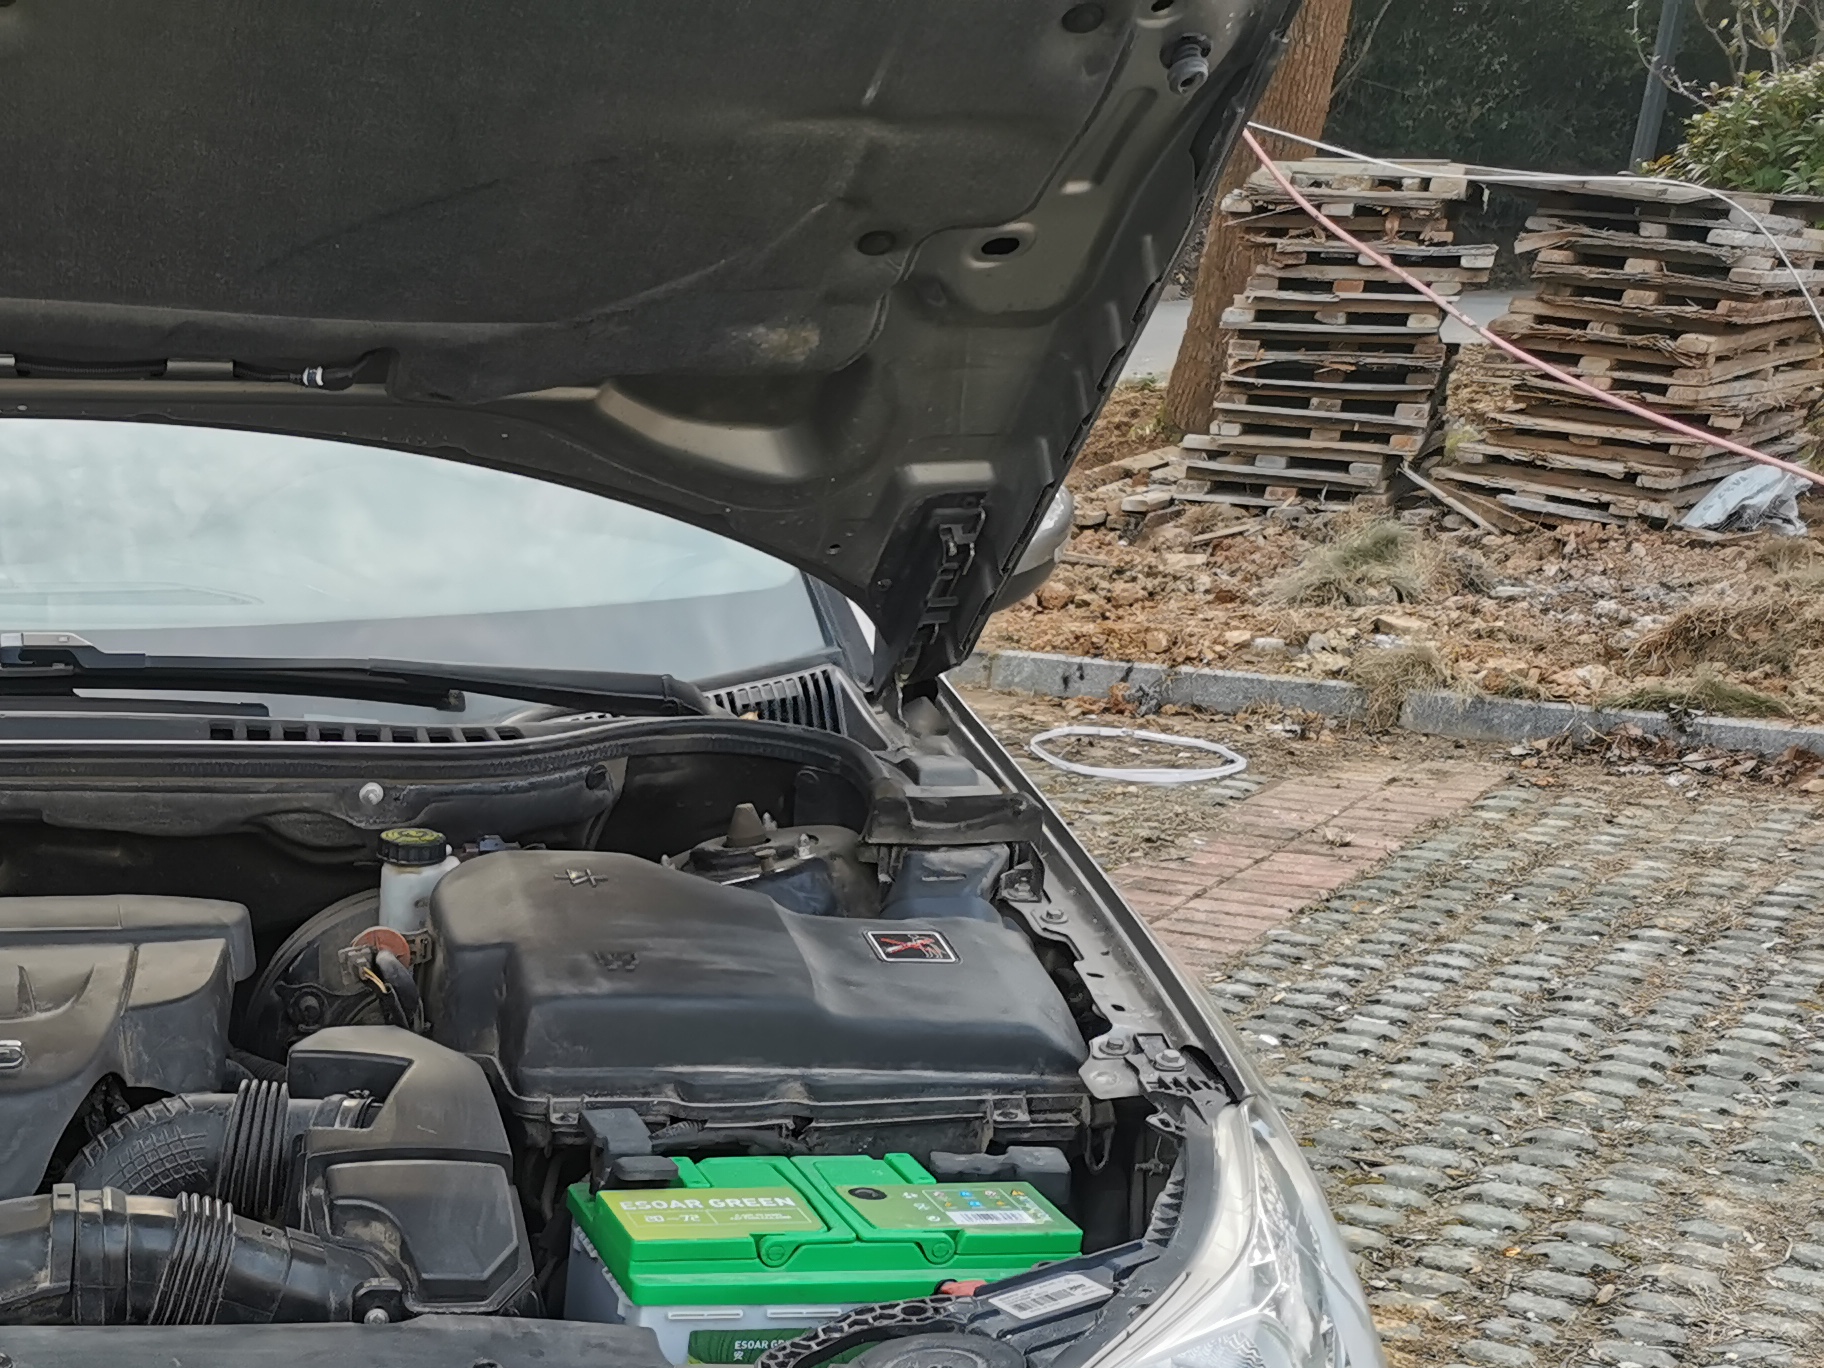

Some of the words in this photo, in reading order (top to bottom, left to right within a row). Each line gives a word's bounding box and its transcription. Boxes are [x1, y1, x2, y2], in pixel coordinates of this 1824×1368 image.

[620, 1199, 704, 1211] ESOAR
[709, 1197, 796, 1208] GREEN
[734, 1339, 768, 1350] ESOAR
